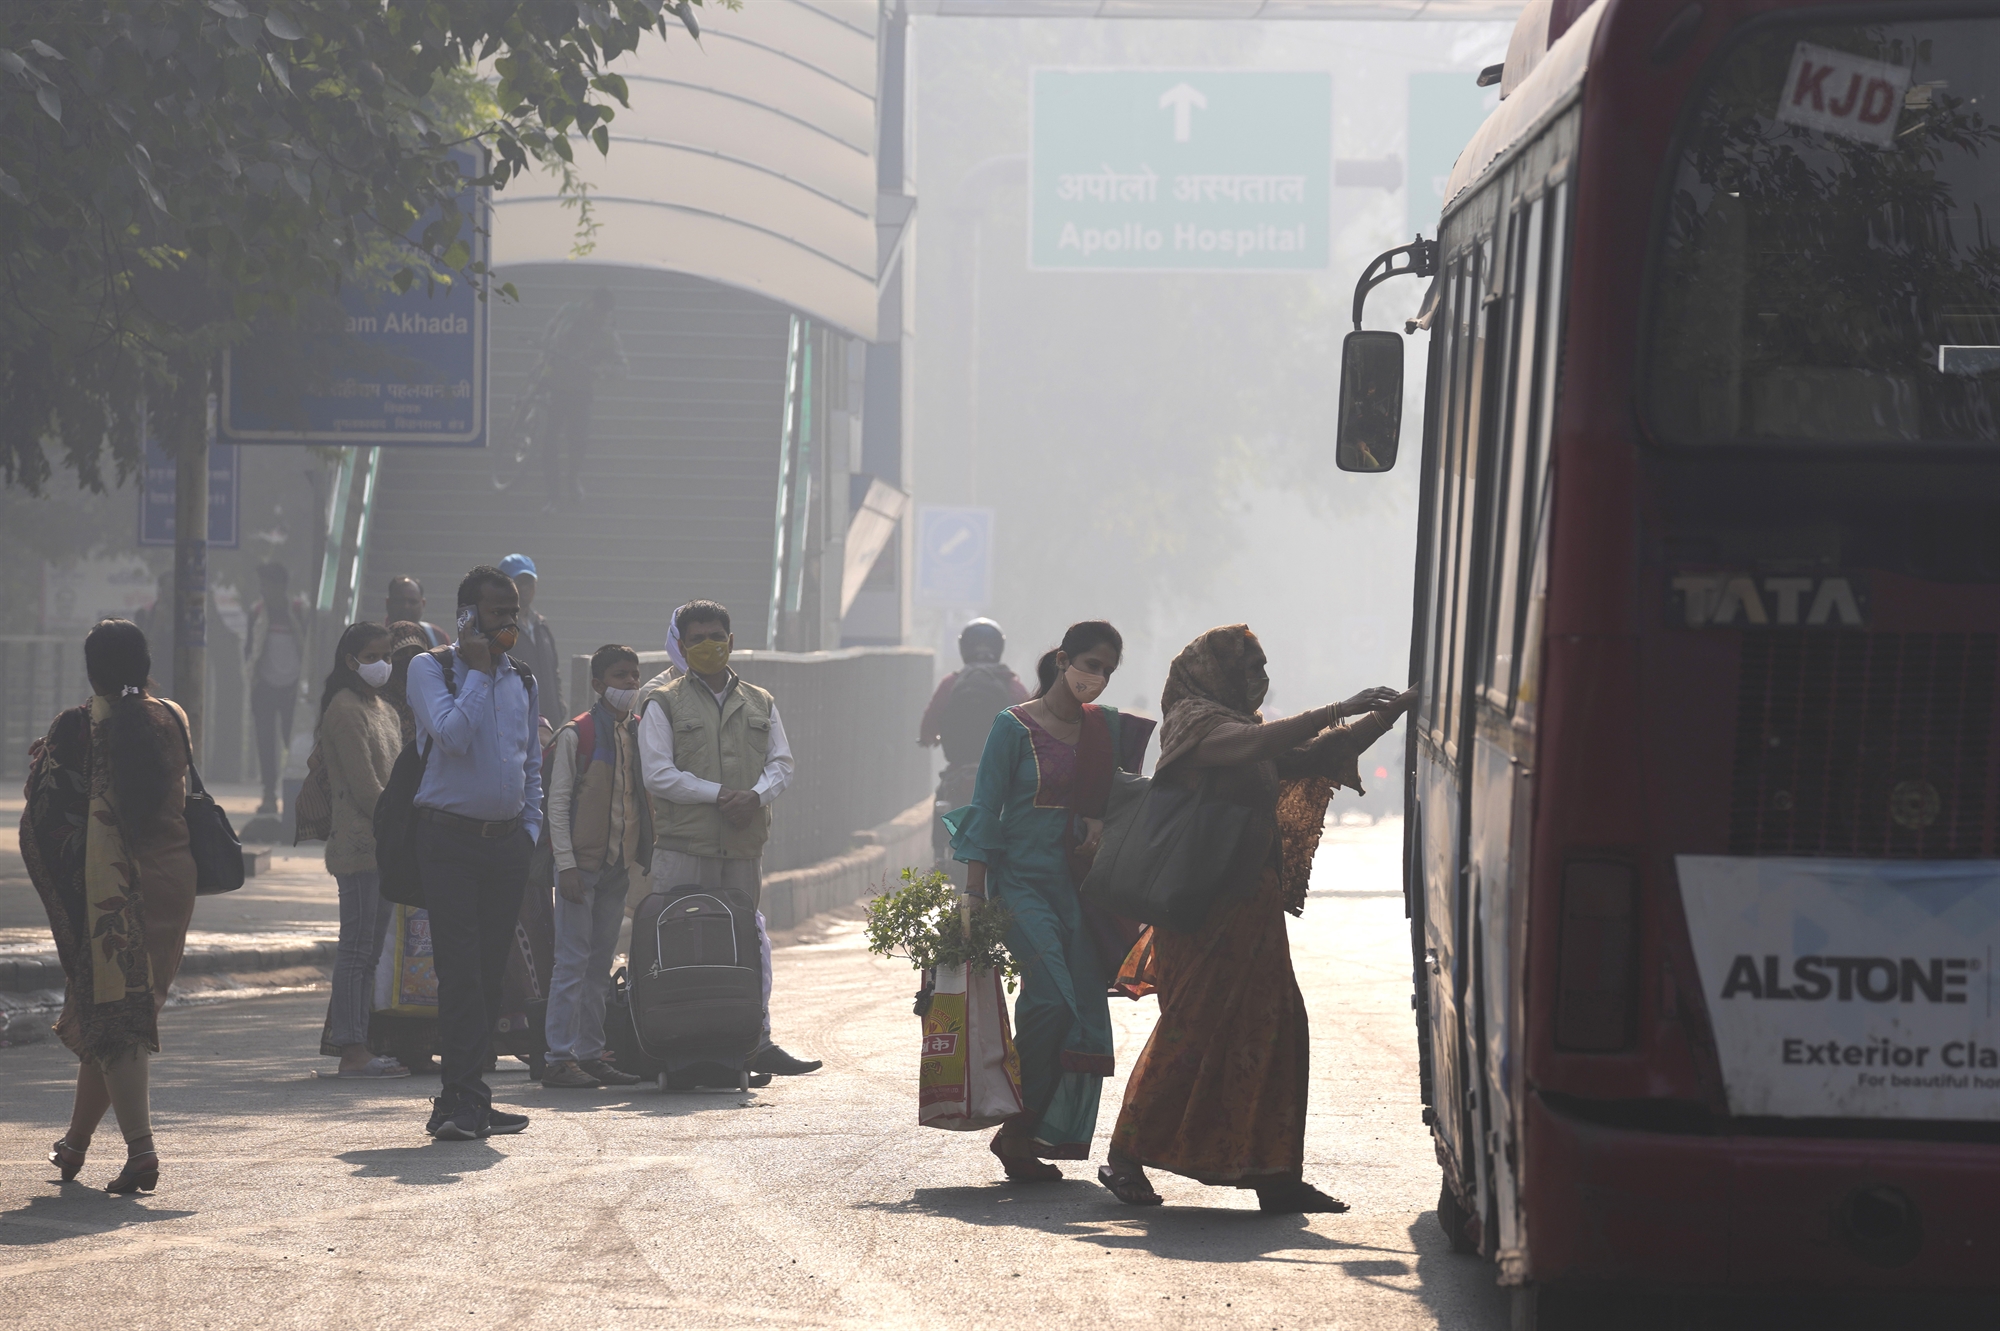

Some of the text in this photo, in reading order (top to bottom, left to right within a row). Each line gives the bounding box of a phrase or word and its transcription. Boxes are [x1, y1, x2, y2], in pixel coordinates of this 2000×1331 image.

[1791, 60, 1895, 125] KJD
[1056, 163, 1306, 204] अपोलो अस्पताल
[1057, 221, 1306, 258] Apollo Hospital
[383, 312, 469, 334] Akhada
[386, 382, 446, 399] पहलवान
[451, 378, 471, 399] जी
[1671, 576, 1863, 626] TATA
[1782, 1037, 2000, 1069] Exterior Cla
[1858, 1073, 1886, 1088] For
[1891, 1073, 1969, 1089] beautiful
